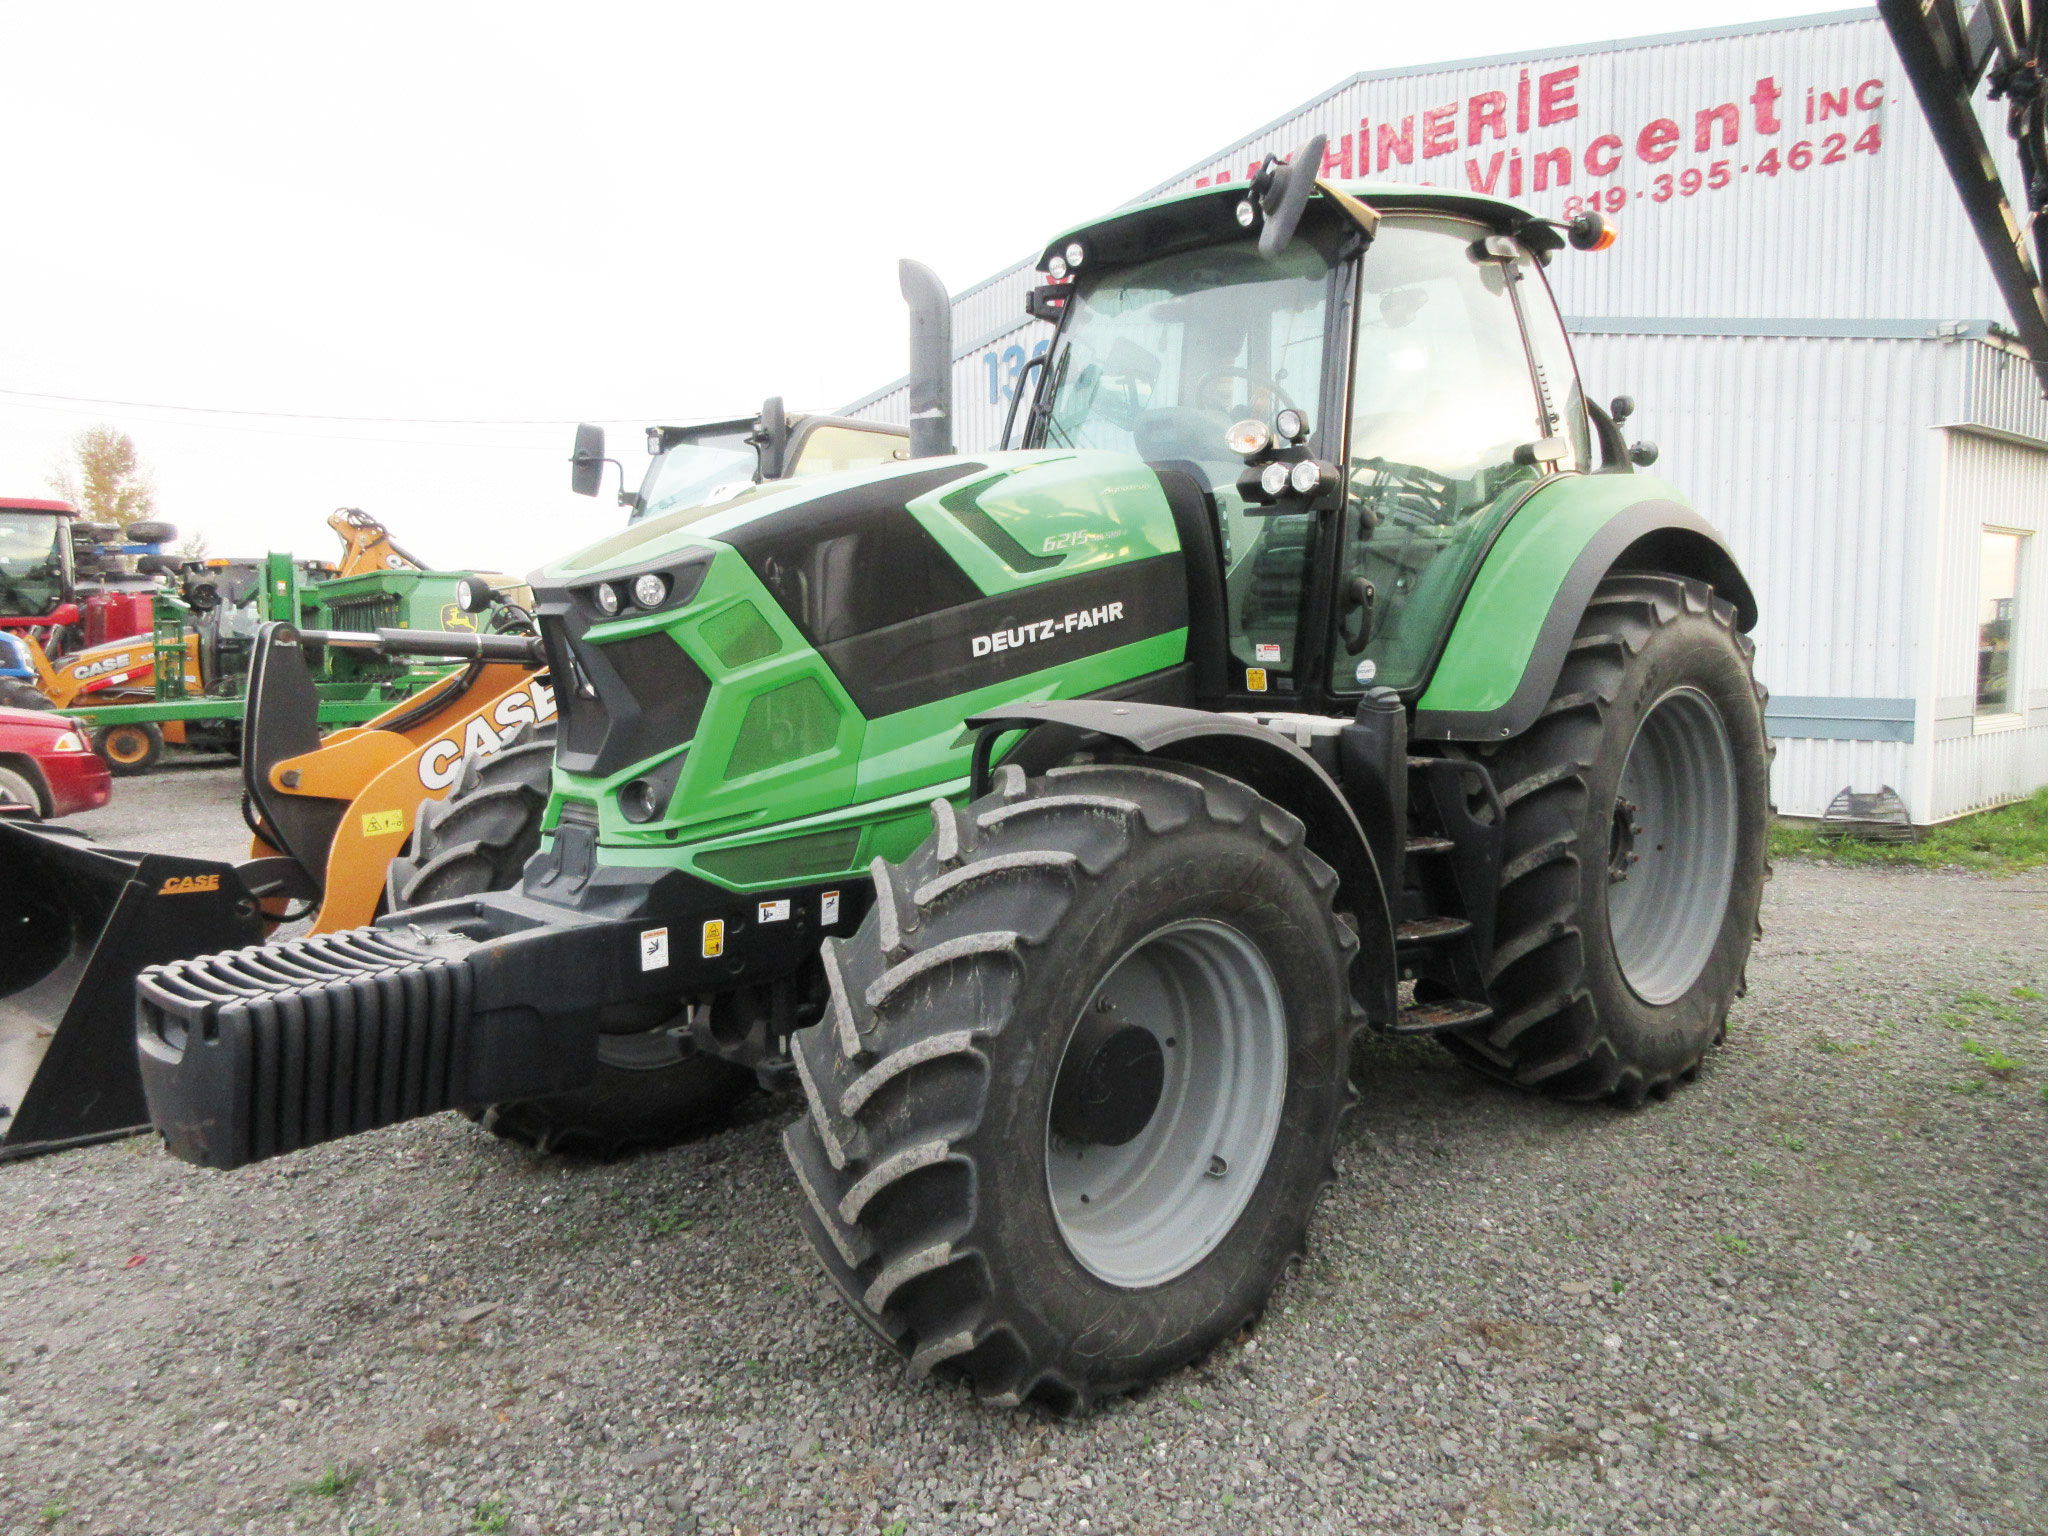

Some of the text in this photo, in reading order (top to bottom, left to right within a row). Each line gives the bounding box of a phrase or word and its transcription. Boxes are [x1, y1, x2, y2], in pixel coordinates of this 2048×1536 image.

[1464, 76, 1783, 198] Vincent
[1042, 529, 1089, 553] 6215
[971, 601, 1125, 658] DEUTZ-FAHR
[73, 653, 131, 680] CASE
[418, 680, 559, 791] CASE
[160, 874, 221, 894] CASE
